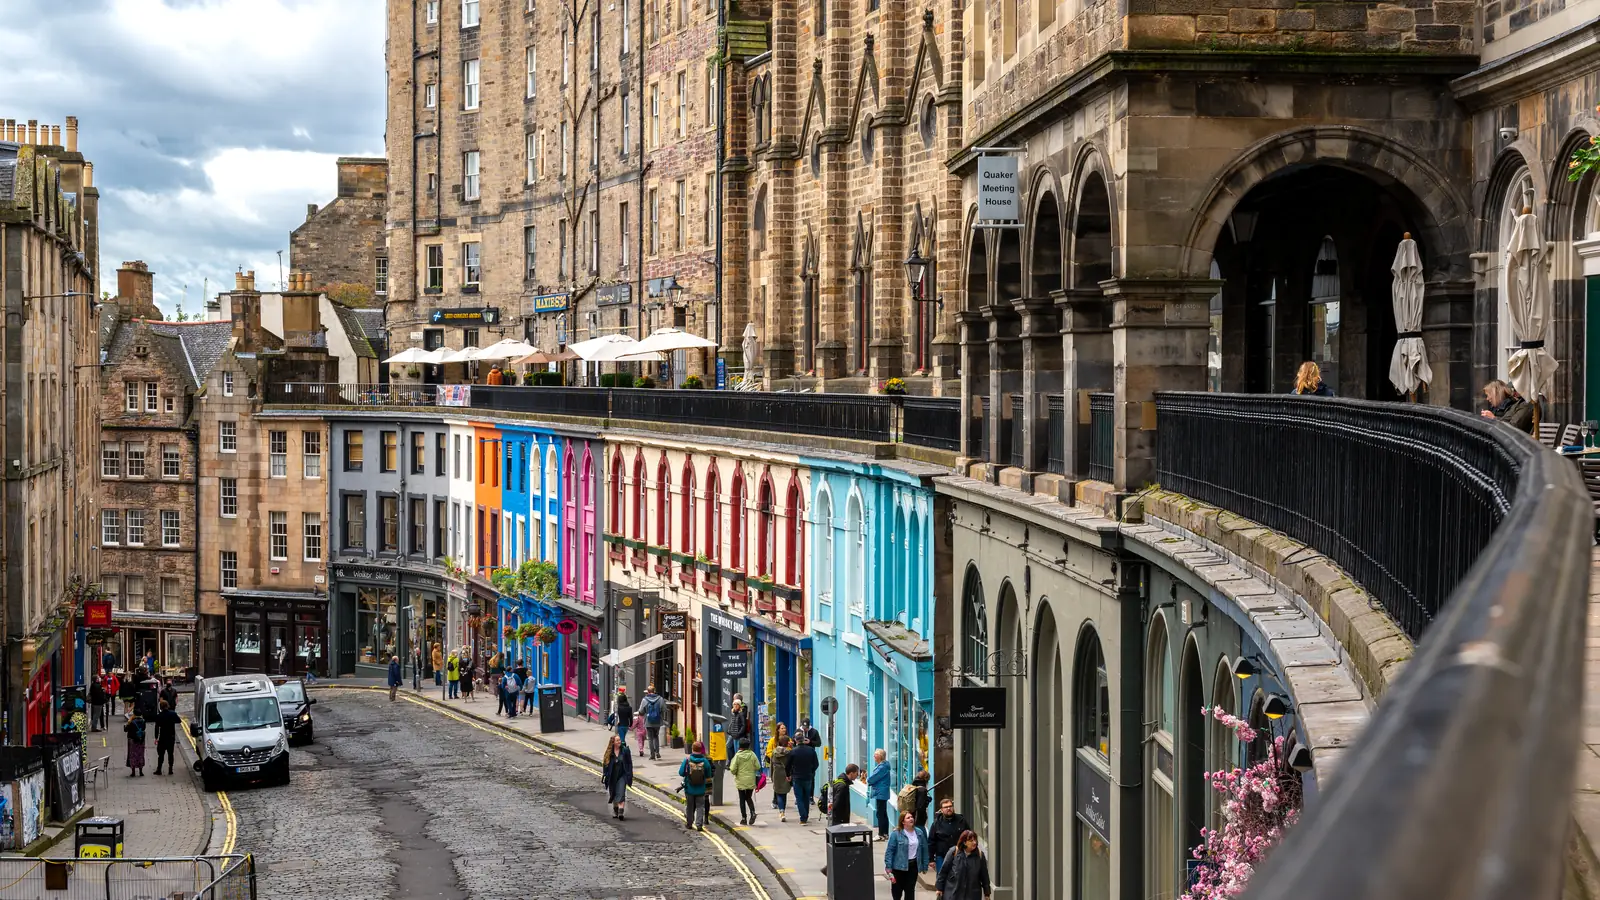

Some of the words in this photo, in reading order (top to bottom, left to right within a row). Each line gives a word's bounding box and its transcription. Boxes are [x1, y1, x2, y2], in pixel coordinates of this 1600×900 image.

[983, 171, 1013, 179] Quaker
[982, 184, 1015, 193] Meeting
[353, 570, 372, 579] Walker
[375, 572, 392, 580] Slater
[710, 612, 719, 624] THE
[718, 612, 733, 630] WHISKY
[733, 621, 744, 634] SHOP
[1085, 803, 1096, 823] Walker
[1095, 811, 1105, 830] Slater
